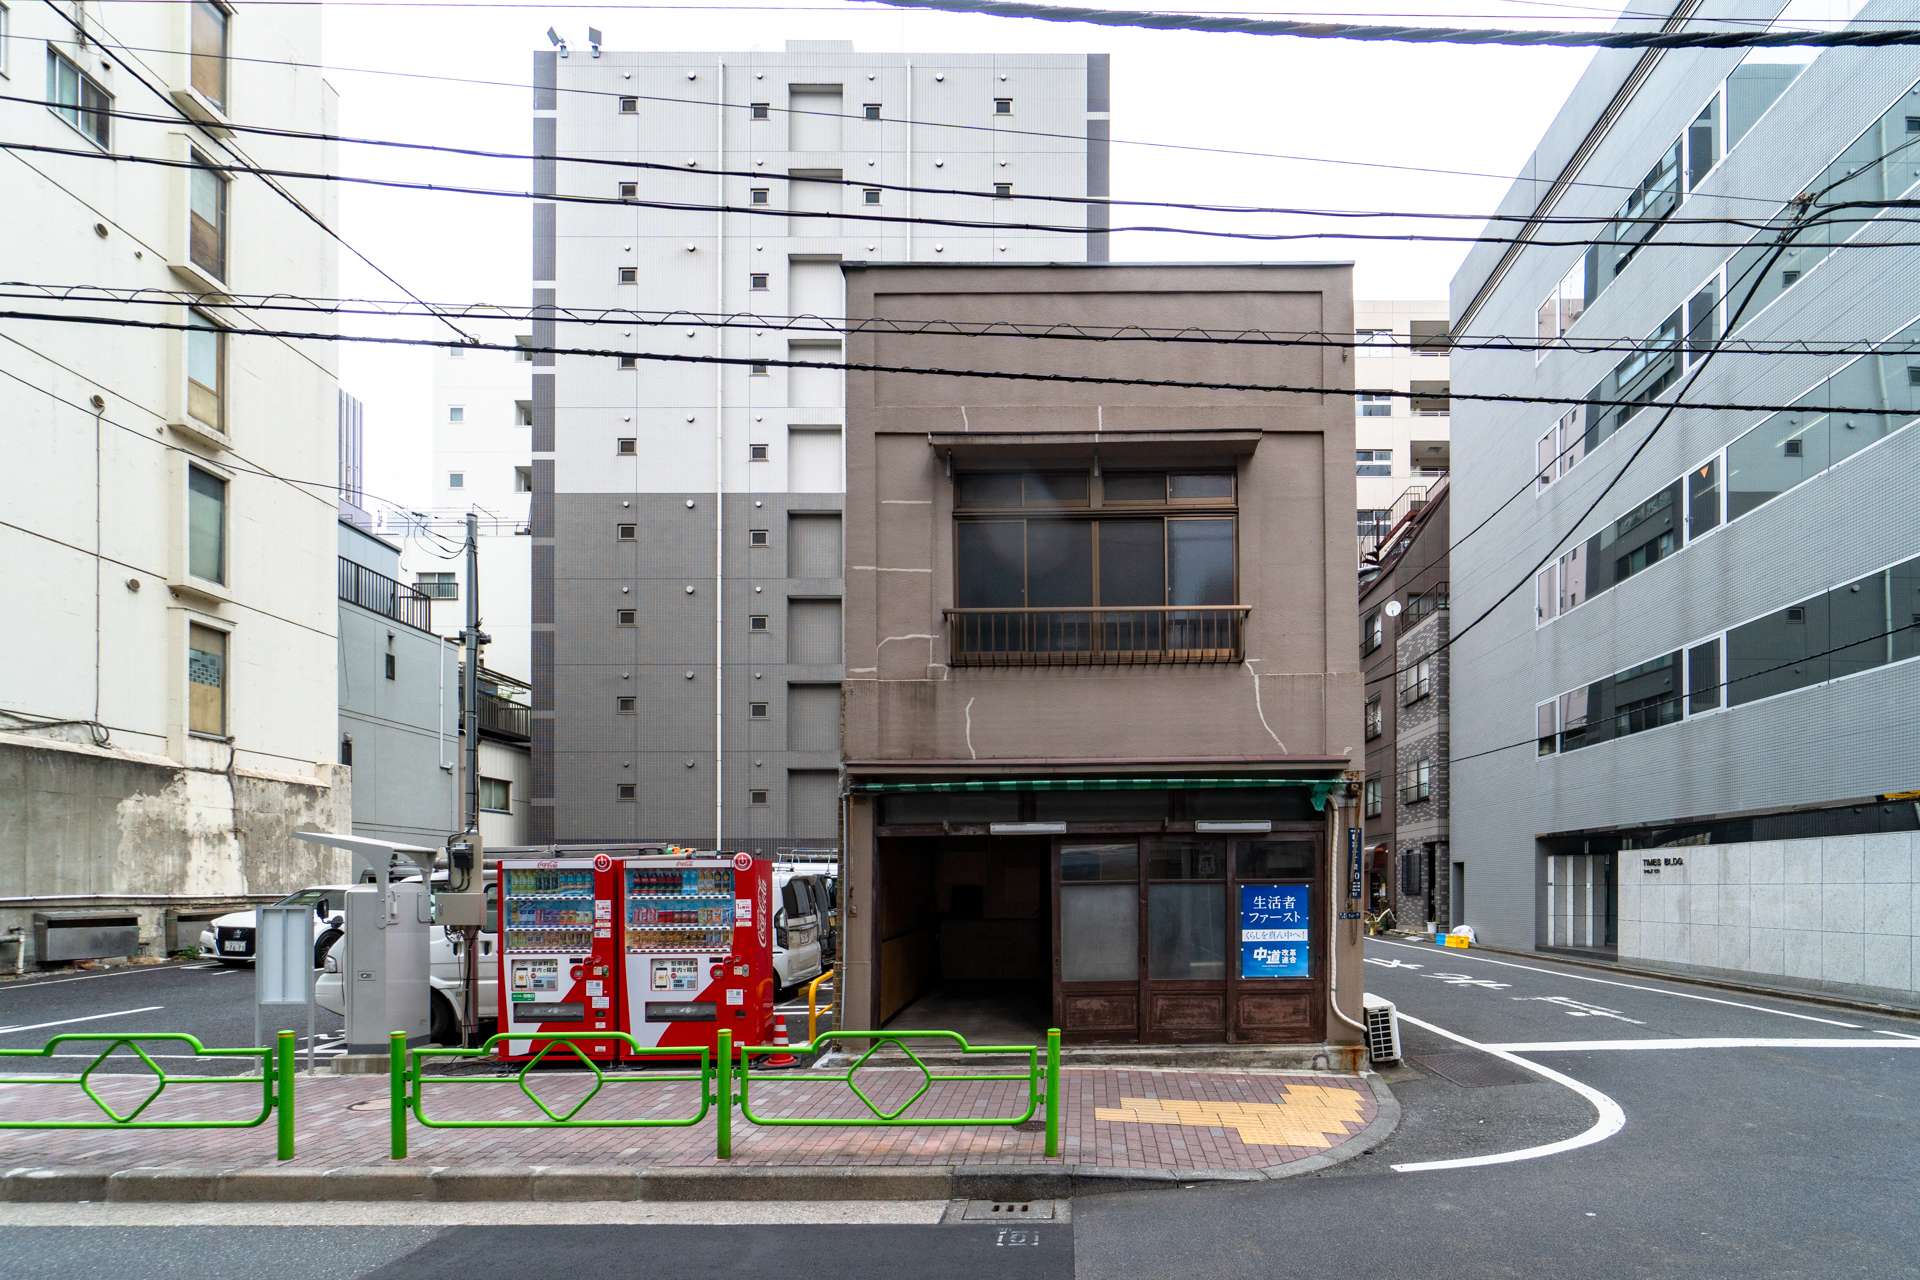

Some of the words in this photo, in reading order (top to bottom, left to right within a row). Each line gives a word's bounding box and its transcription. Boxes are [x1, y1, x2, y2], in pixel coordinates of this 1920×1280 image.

[537, 860, 558, 868] Coca-Cola
[1643, 858, 1662, 867] TIMES
[1253, 895, 1296, 909] 生活者
[757, 874, 767, 948] Coca-Cola
[1249, 911, 1301, 924] ファースト
[1253, 946, 1281, 964] 中道
